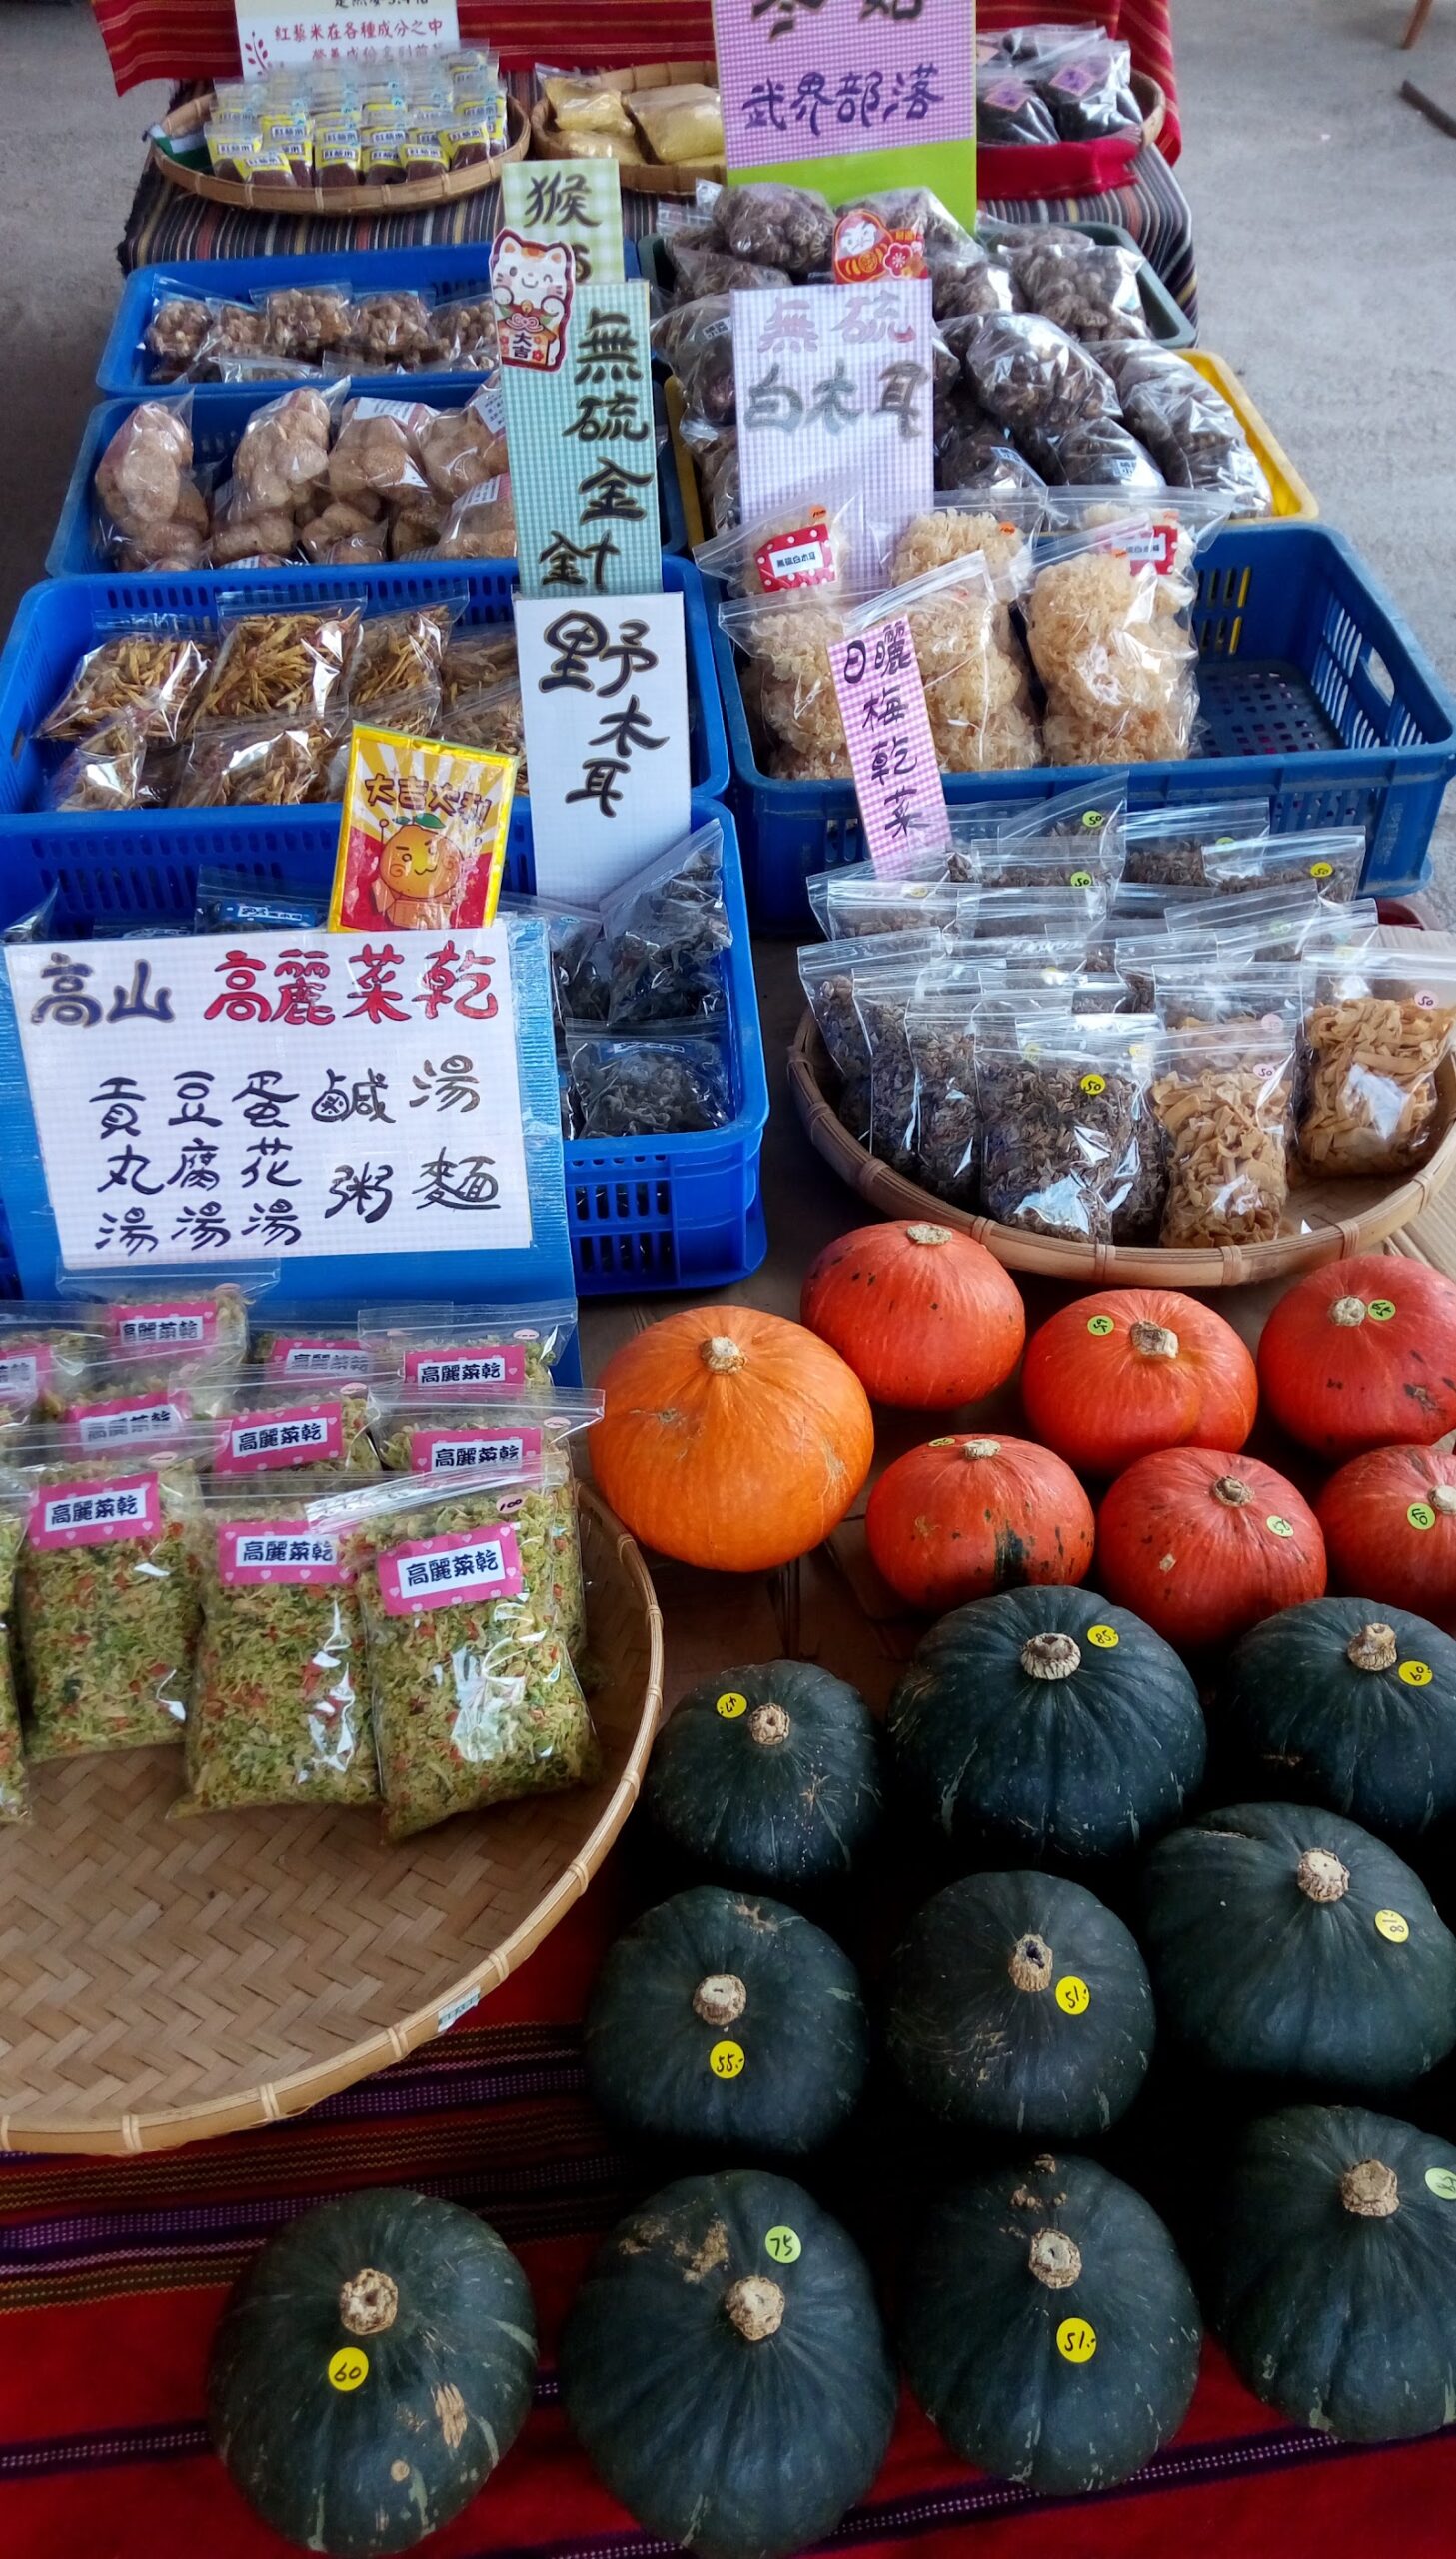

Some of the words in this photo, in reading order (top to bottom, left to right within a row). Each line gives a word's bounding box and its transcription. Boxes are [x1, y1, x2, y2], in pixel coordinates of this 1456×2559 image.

[742, 62, 944, 137] 武界部落
[756, 289, 916, 354] 無硫
[512, 332, 532, 359] 大吉
[743, 357, 931, 439] 白木耳
[538, 306, 655, 593] 無硫金針
[538, 609, 671, 819] 野木耳
[1088, 815, 1102, 826] 50
[1074, 877, 1090, 888] 50
[31, 951, 176, 1030] 高山
[203, 940, 499, 1027] 高麗菜乾
[1417, 995, 1434, 1007] 50
[1258, 1068, 1273, 1078] 50
[1085, 1080, 1102, 1092] 50
[421, 1361, 502, 1385] 高麗菜乾
[238, 1422, 323, 1453] 高麗菜乾
[435, 1445, 521, 1468] 高麗菜乾
[51, 1494, 139, 1526] 高麗菜乾
[500, 1498, 522, 1512] 100
[243, 1540, 334, 1562] 高麗菜乾
[406, 1549, 500, 1587] 高麗菜乾
[769, 2233, 793, 2257] 75
[334, 2361, 362, 2382] 60
